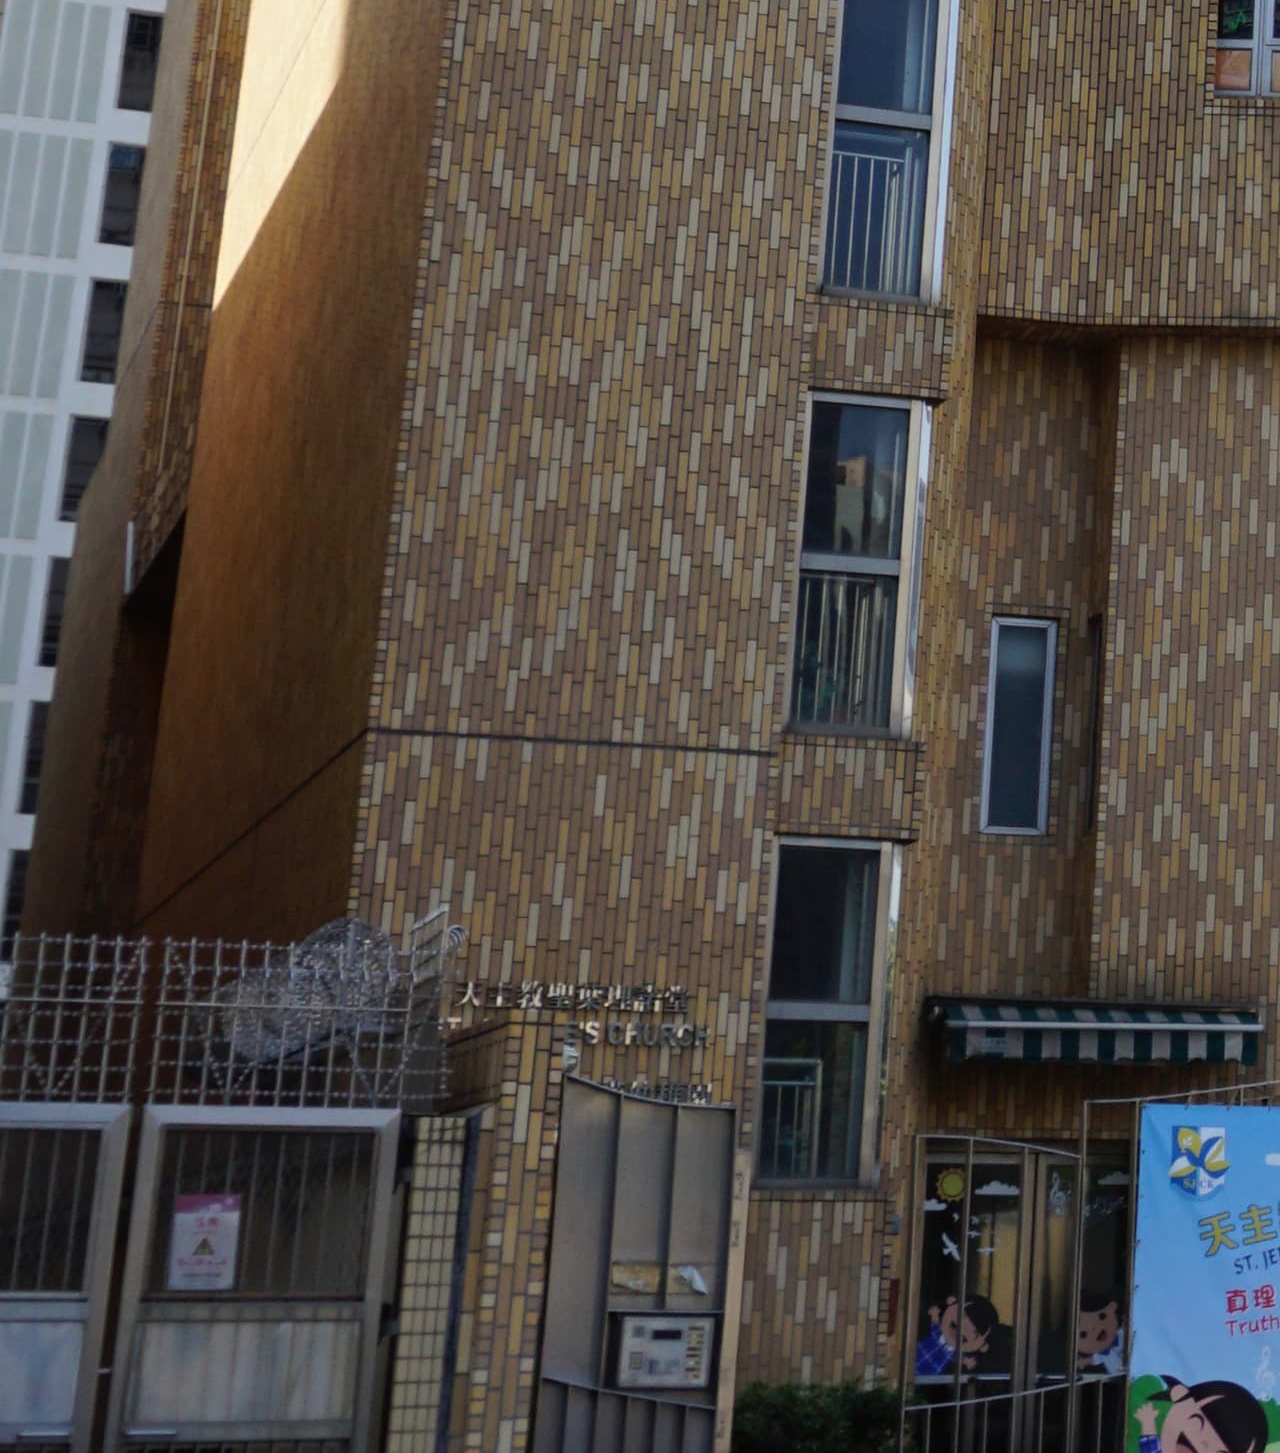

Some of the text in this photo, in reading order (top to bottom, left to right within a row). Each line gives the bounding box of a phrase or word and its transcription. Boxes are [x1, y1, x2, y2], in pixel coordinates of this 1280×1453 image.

[608, 1022, 712, 1047] CHURCH
[1233, 1256, 1259, 1275] ST.
[1225, 1284, 1277, 1314] 真理
[1226, 1314, 1280, 1338] Truth
